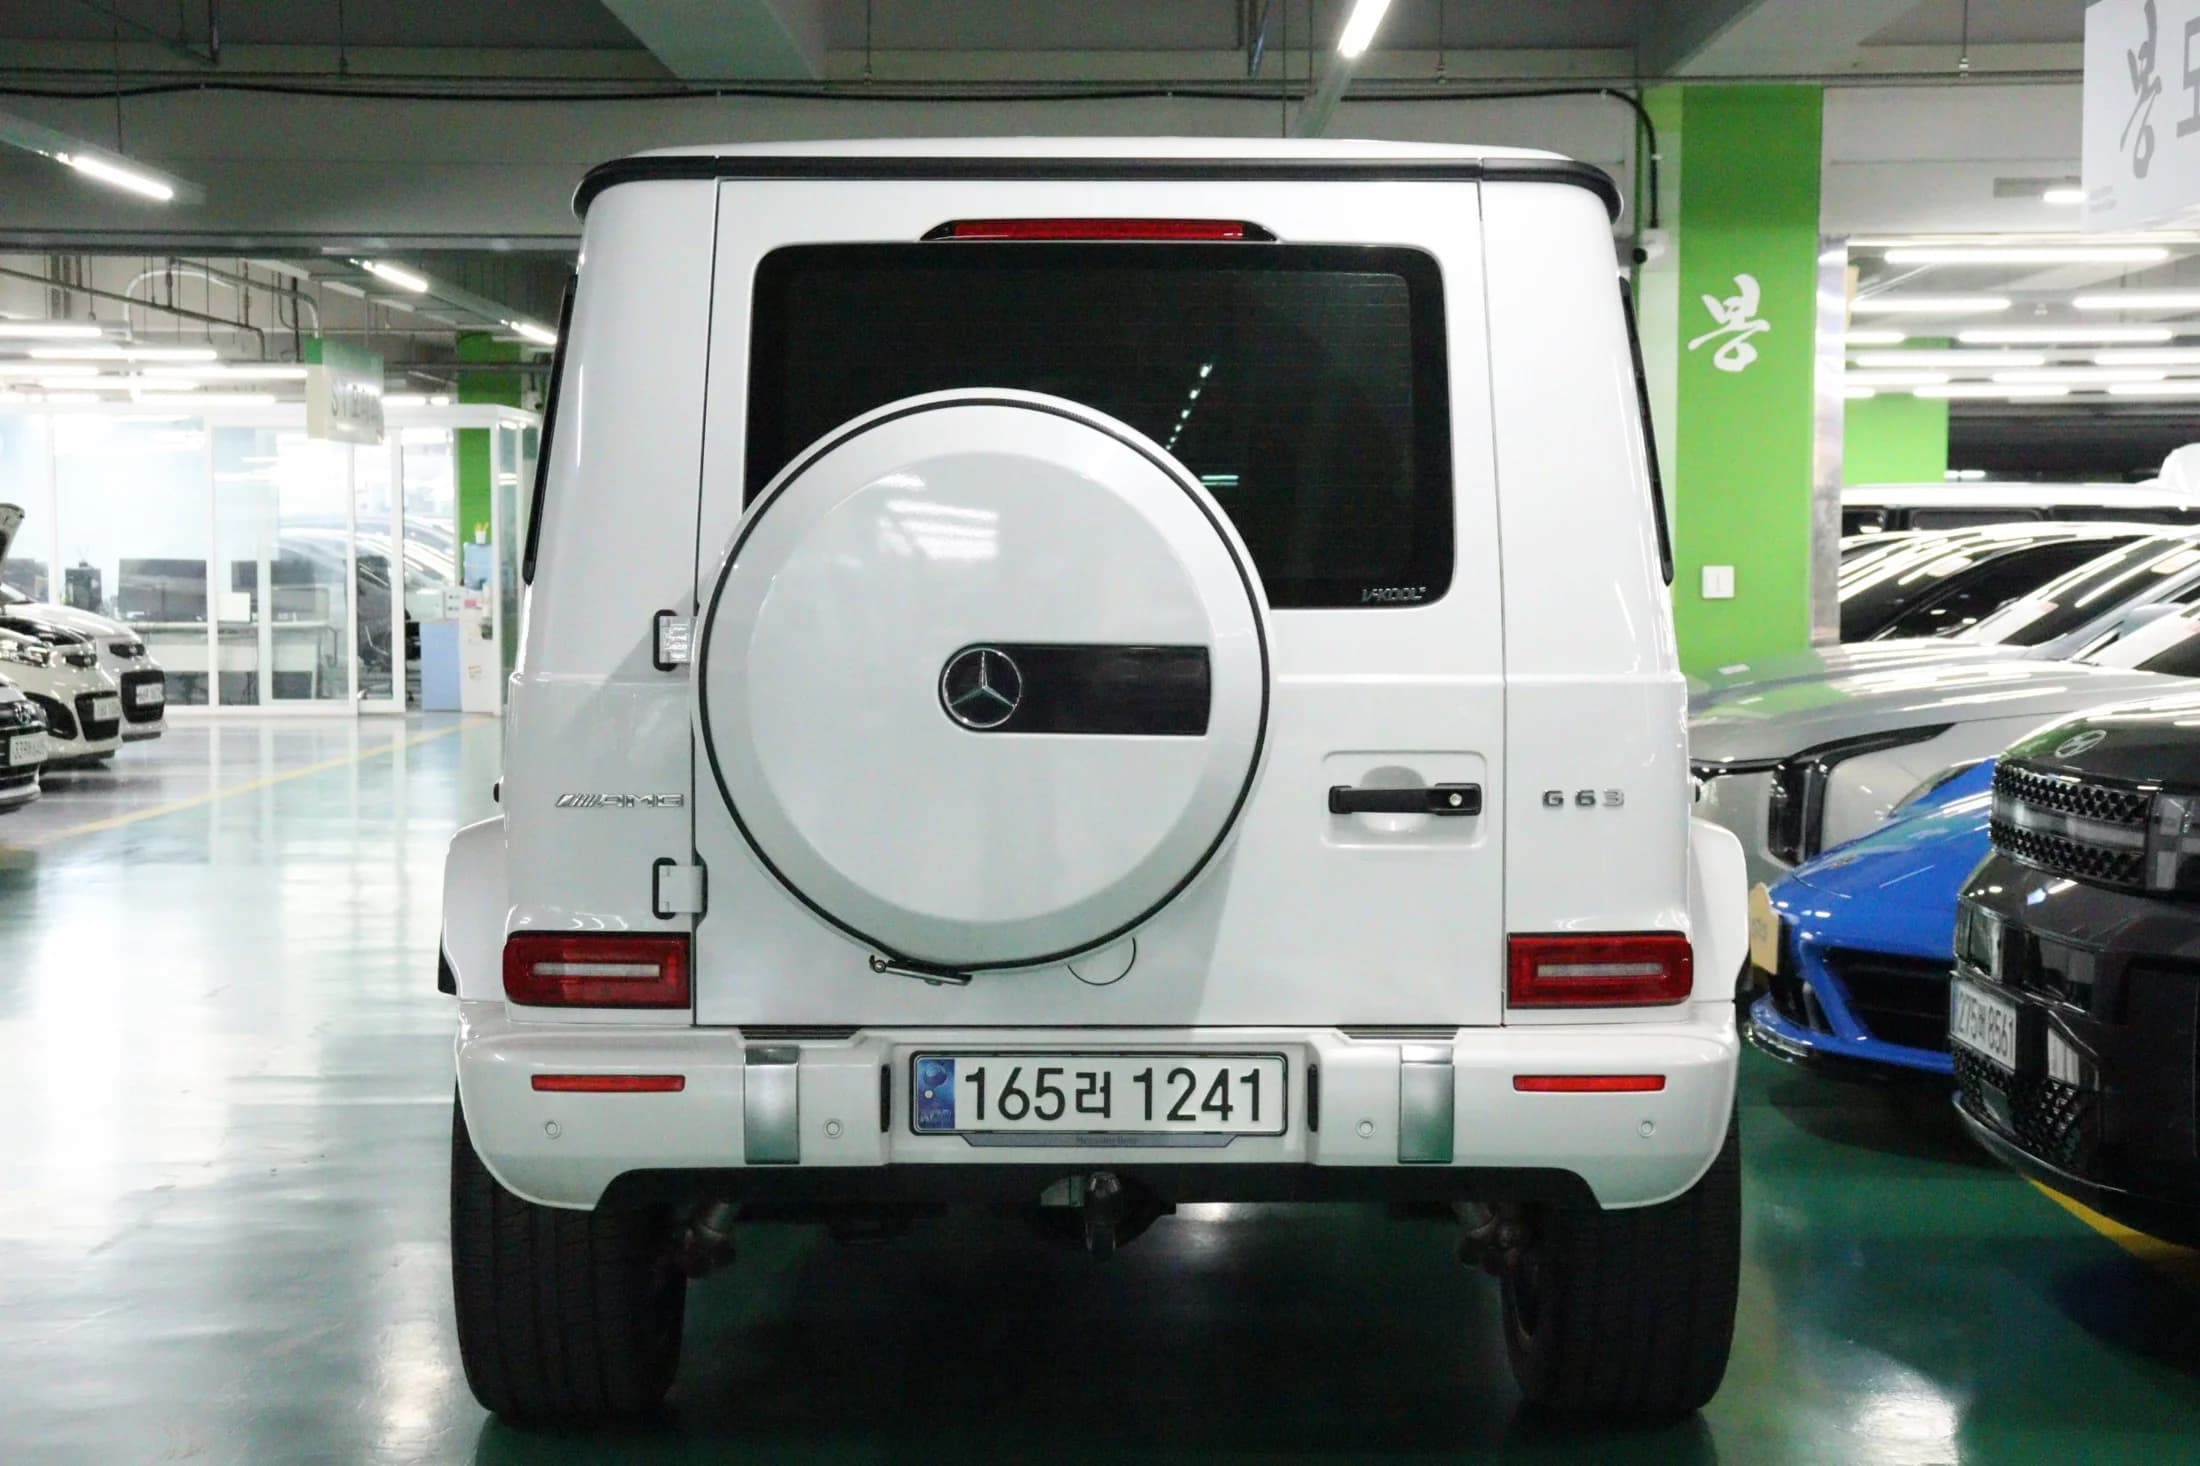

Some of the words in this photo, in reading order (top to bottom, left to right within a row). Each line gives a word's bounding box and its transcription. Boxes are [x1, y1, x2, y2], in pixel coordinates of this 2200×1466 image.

[598, 793, 684, 808] AMG
[965, 1067, 1111, 1120] 165러
[1133, 1067, 1261, 1122] 1241
